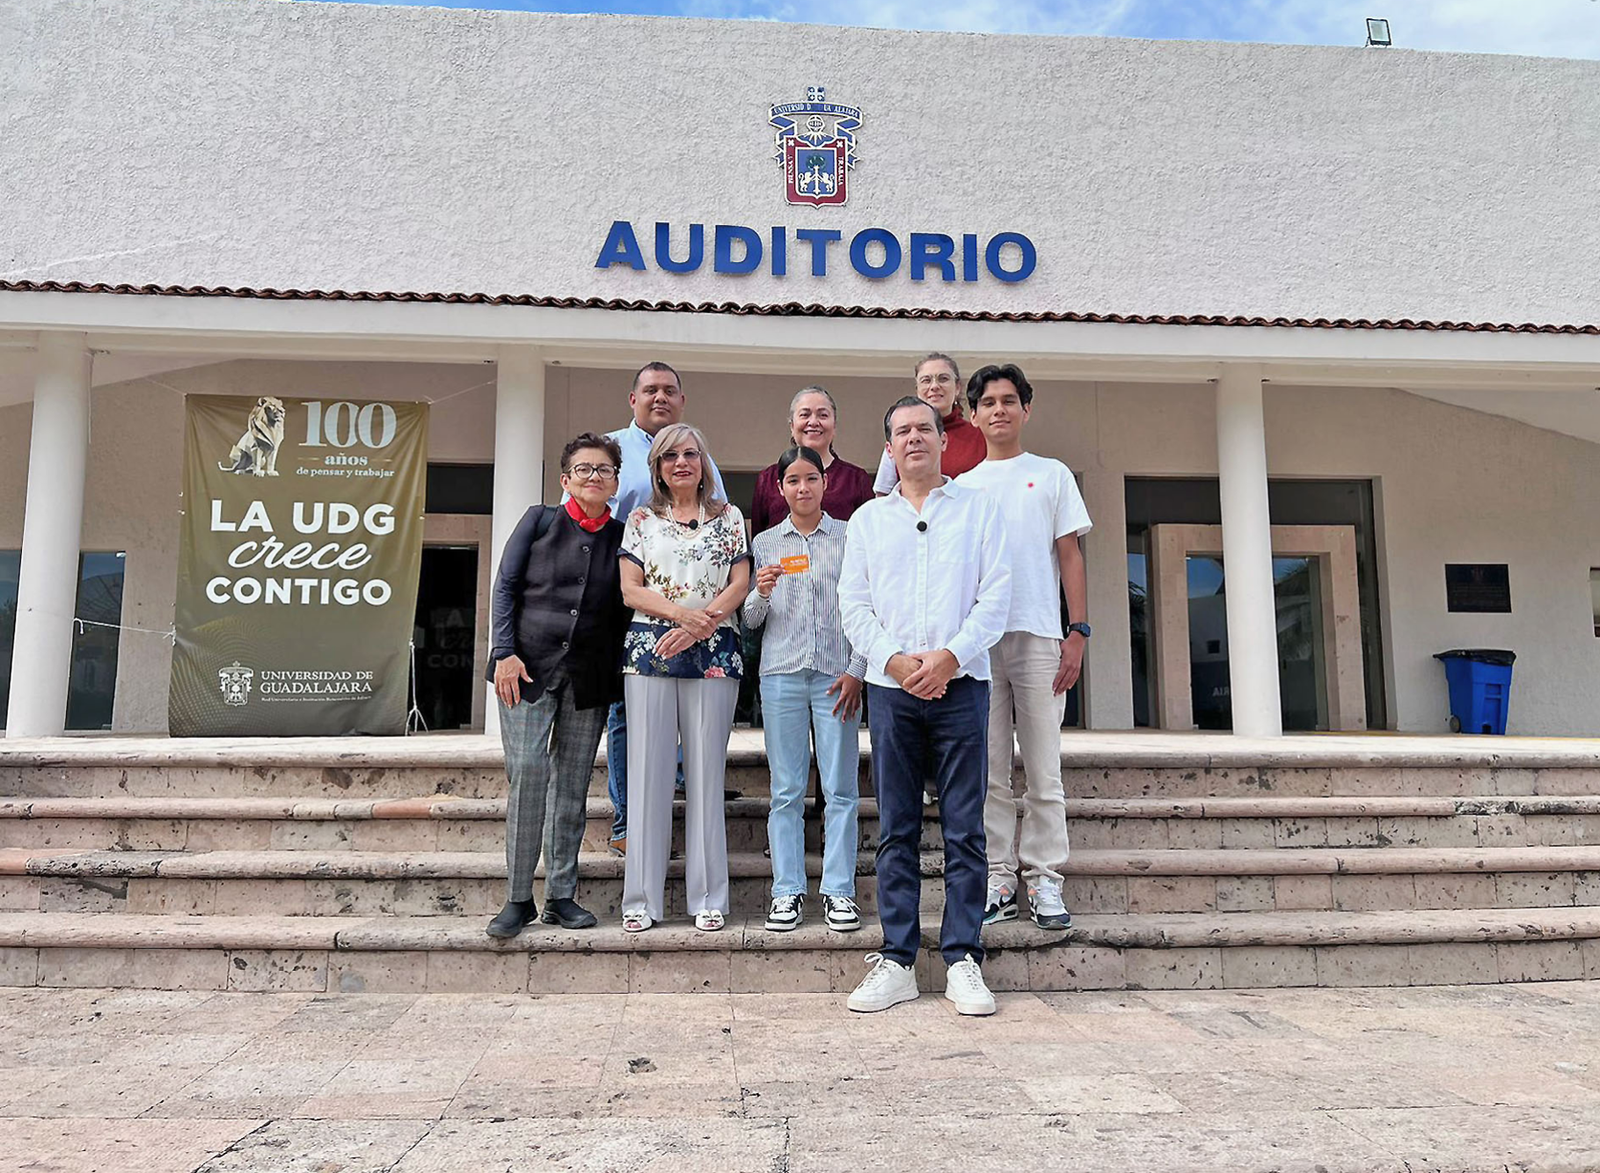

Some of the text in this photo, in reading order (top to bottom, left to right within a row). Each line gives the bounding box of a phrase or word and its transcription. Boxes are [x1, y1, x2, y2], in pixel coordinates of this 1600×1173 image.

[594, 220, 1037, 282] AUDITORIO
[298, 401, 397, 449] 100
[296, 466, 395, 479] de pensar y trabajar
[324, 452, 368, 466] años
[211, 500, 395, 535] LA UDG
[228, 535, 372, 570] crece
[206, 577, 392, 606] CONTIGO
[260, 682, 373, 694] GUADALAJARA
[261, 671, 374, 681] UNIVERSIDAD DE
